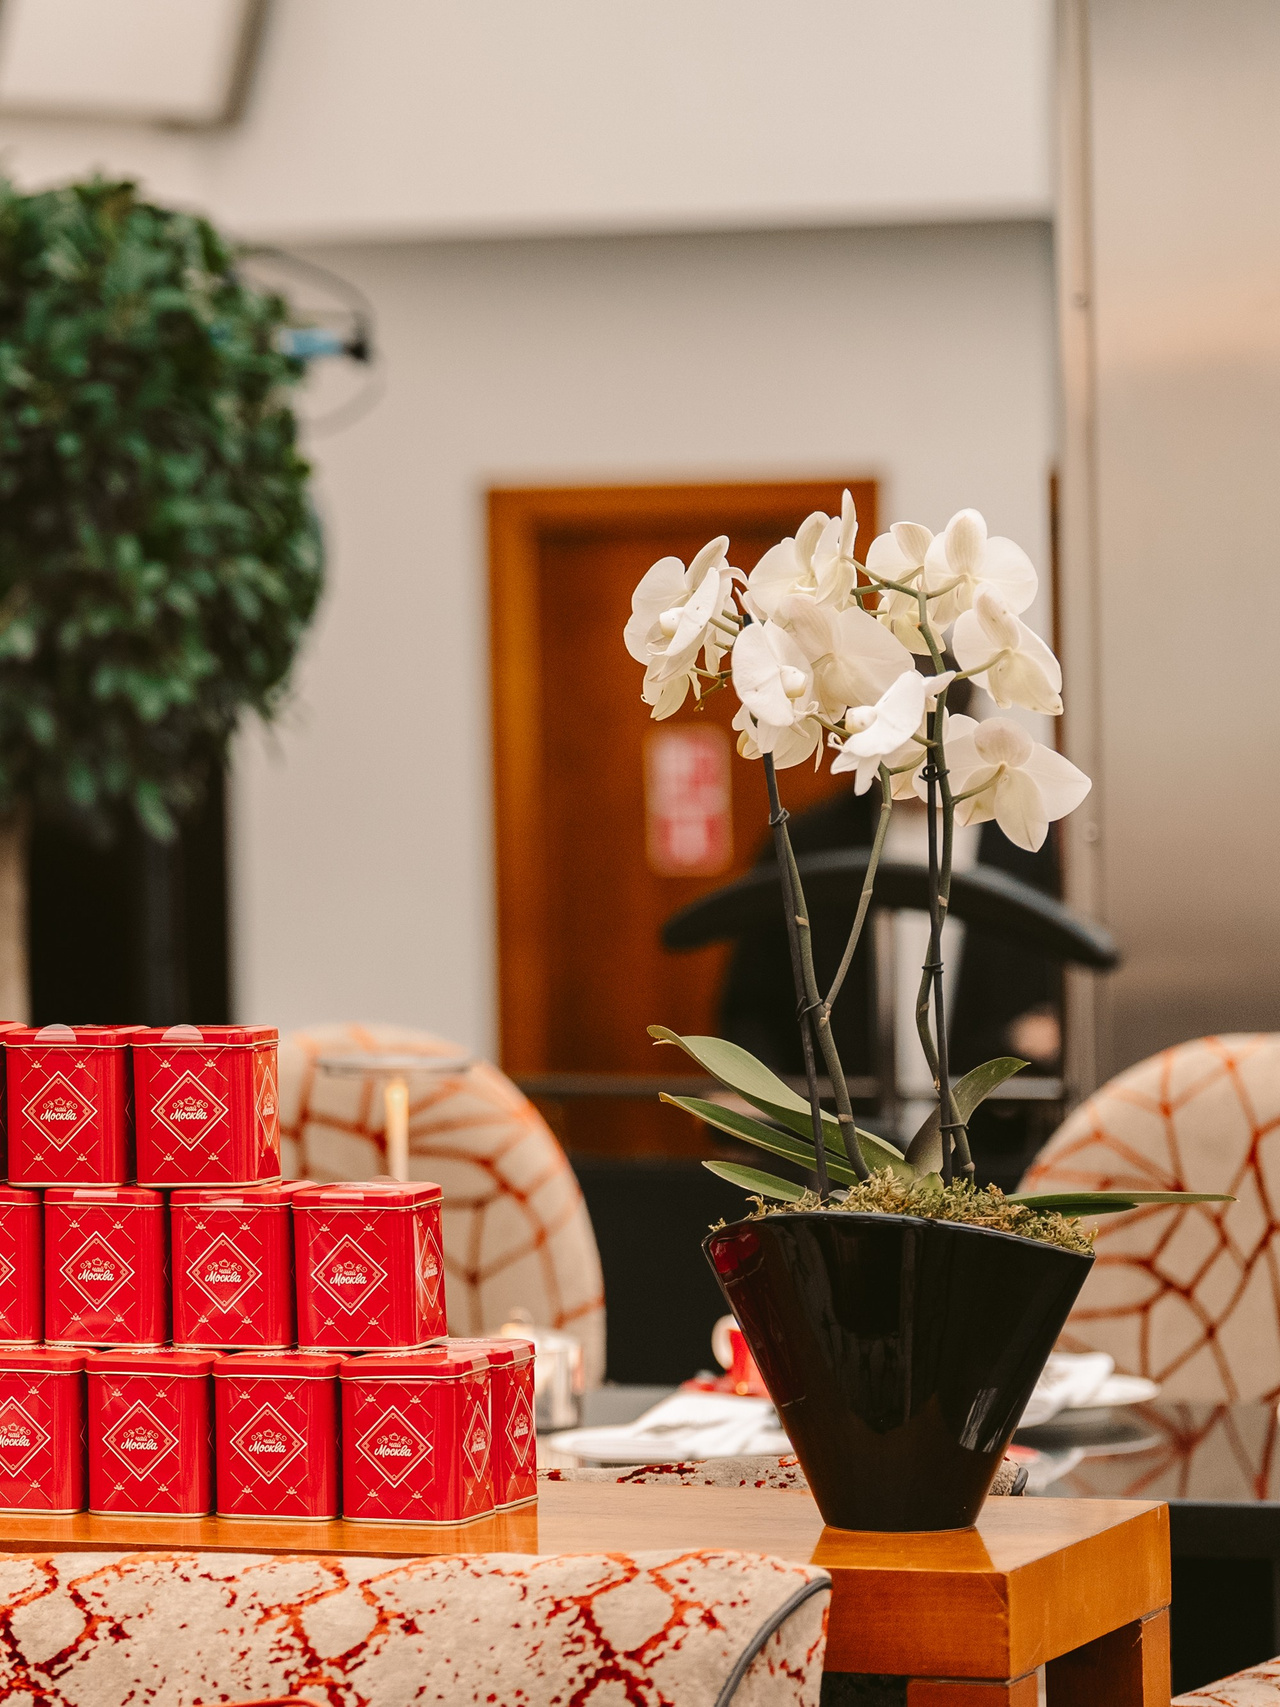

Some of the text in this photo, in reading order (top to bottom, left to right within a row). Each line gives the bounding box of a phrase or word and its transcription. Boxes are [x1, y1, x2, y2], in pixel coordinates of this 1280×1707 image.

[41, 1109, 77, 1121] Москва
[170, 1109, 207, 1121] Москва
[78, 1270, 114, 1282] Москва
[205, 1271, 241, 1283] Москва
[330, 1273, 367, 1285] Москва
[121, 1439, 158, 1451] Москва
[249, 1441, 286, 1454] Москва
[374, 1445, 412, 1457] Москва
